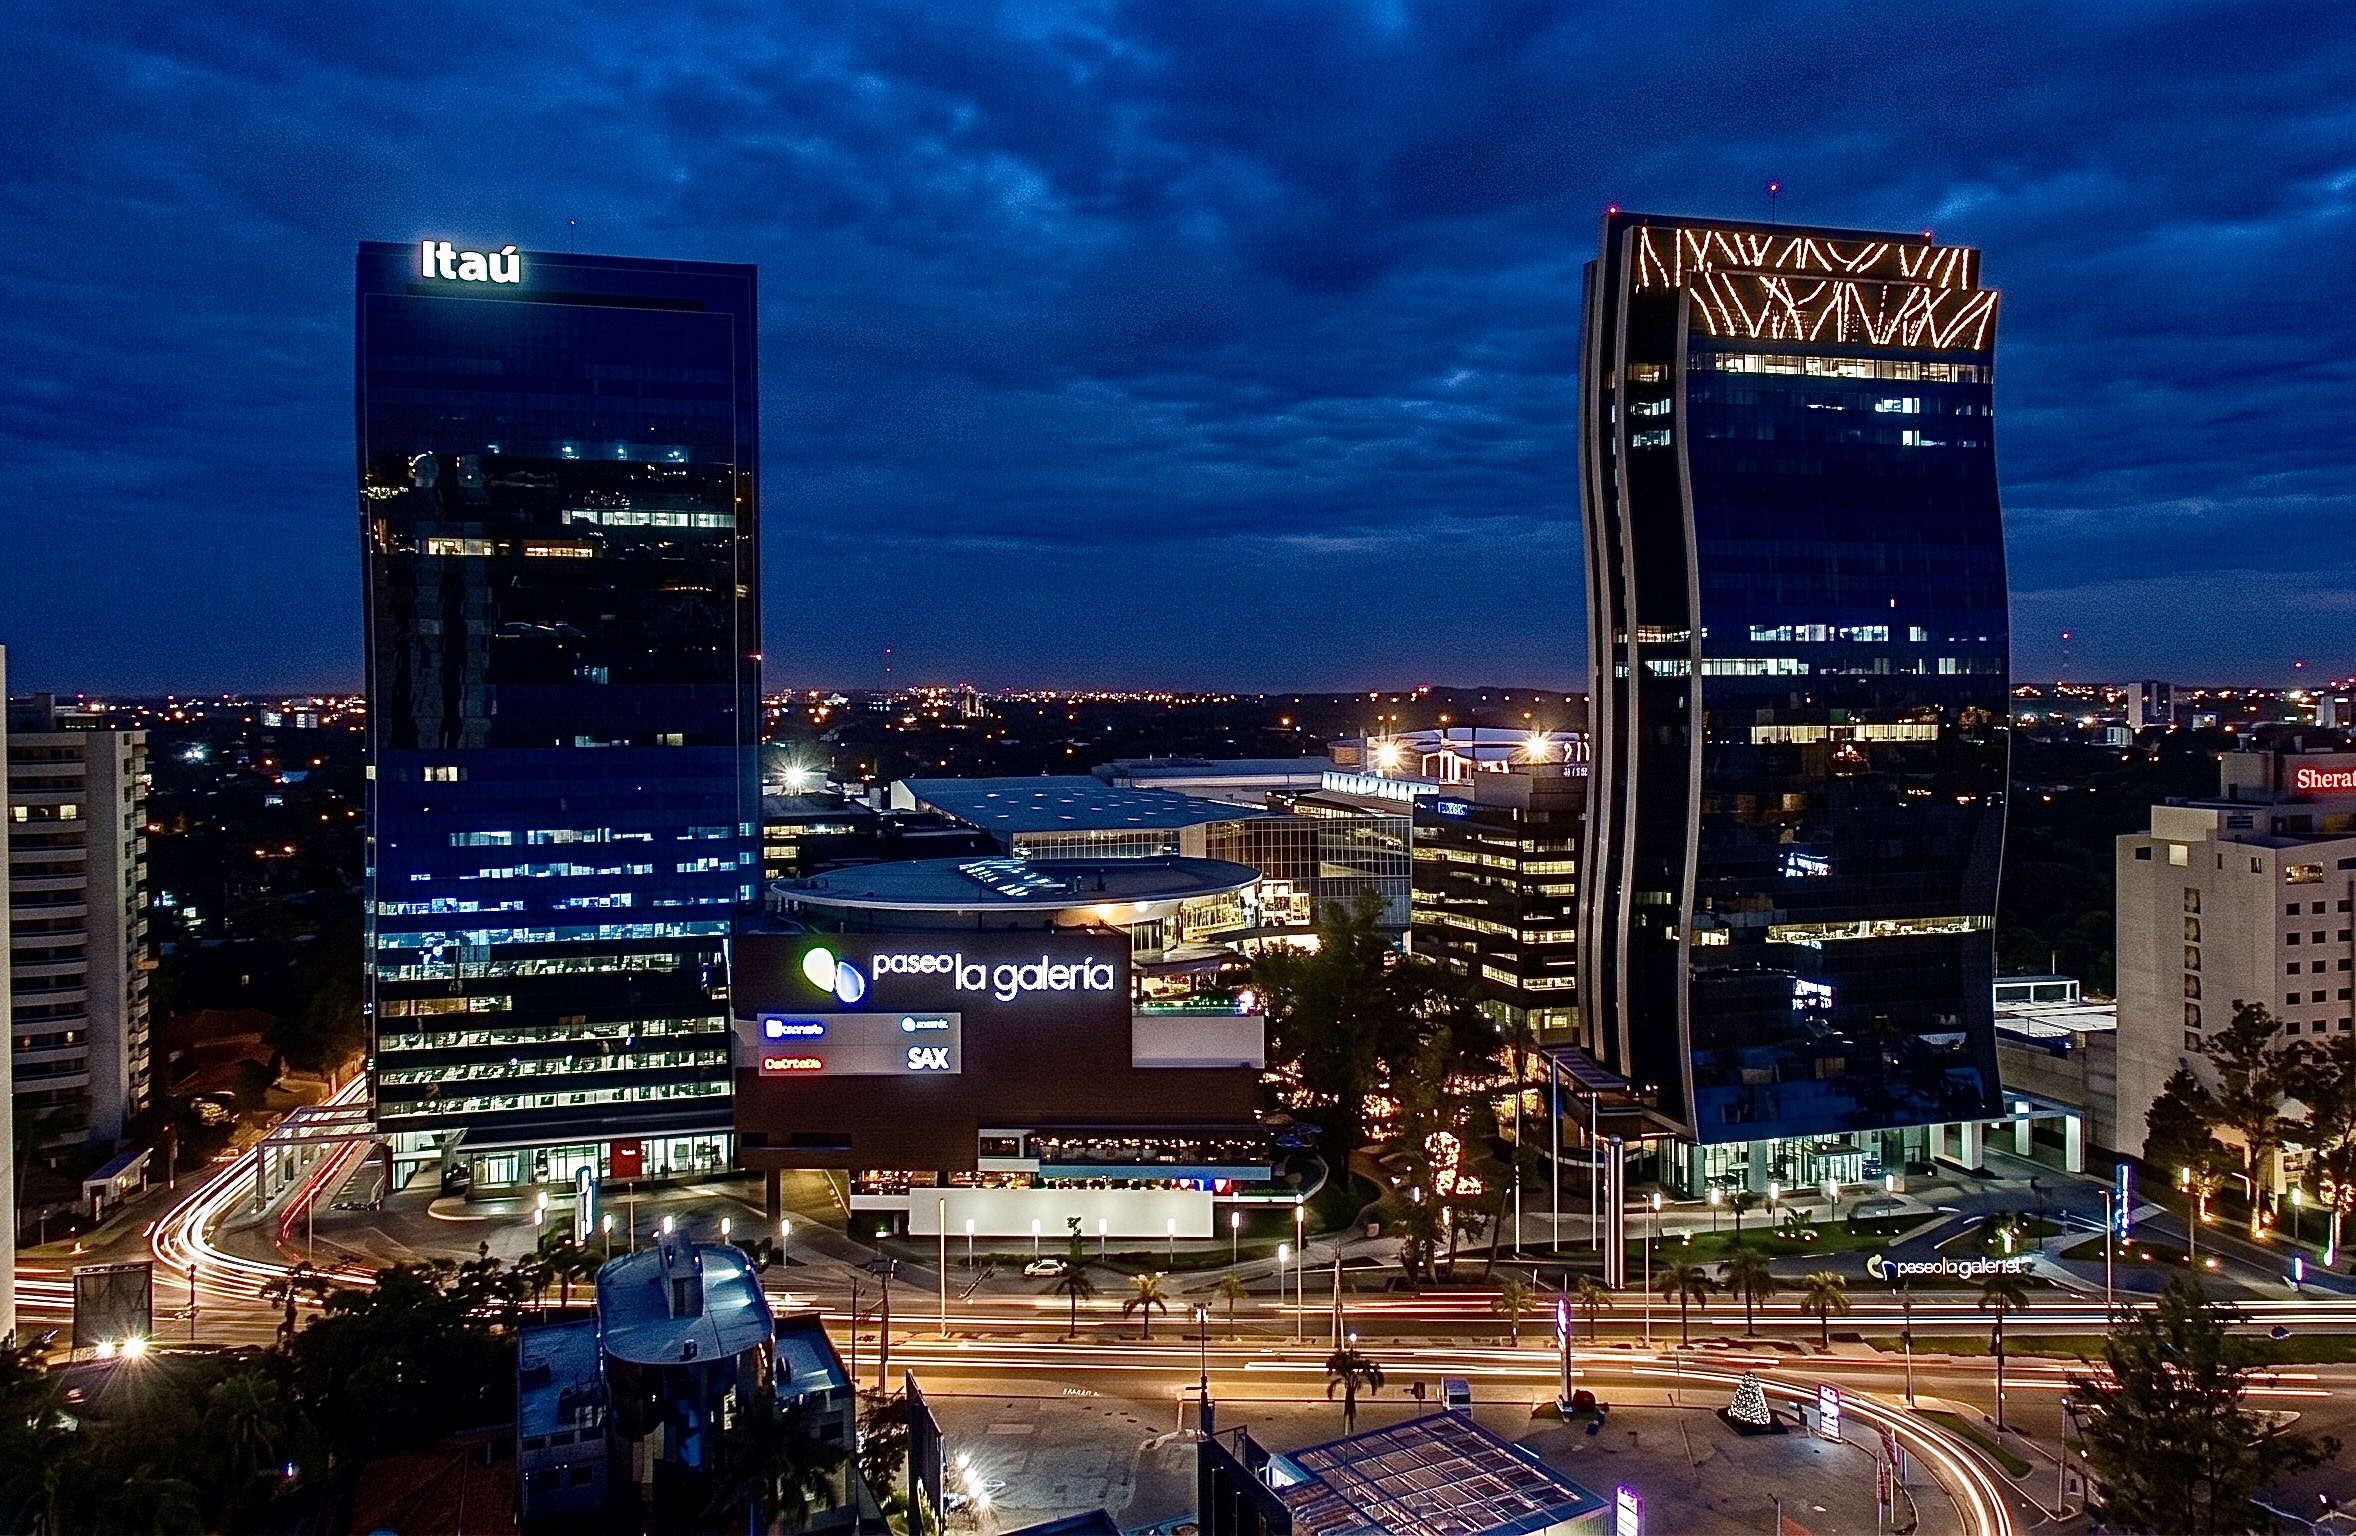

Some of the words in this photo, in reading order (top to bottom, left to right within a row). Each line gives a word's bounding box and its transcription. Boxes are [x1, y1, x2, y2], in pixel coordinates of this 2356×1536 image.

[422, 240, 520, 284] Itaú
[872, 953, 954, 981] paseo
[955, 952, 987, 991] la
[993, 954, 1115, 1002] galería
[907, 1046, 950, 1070] SAX
